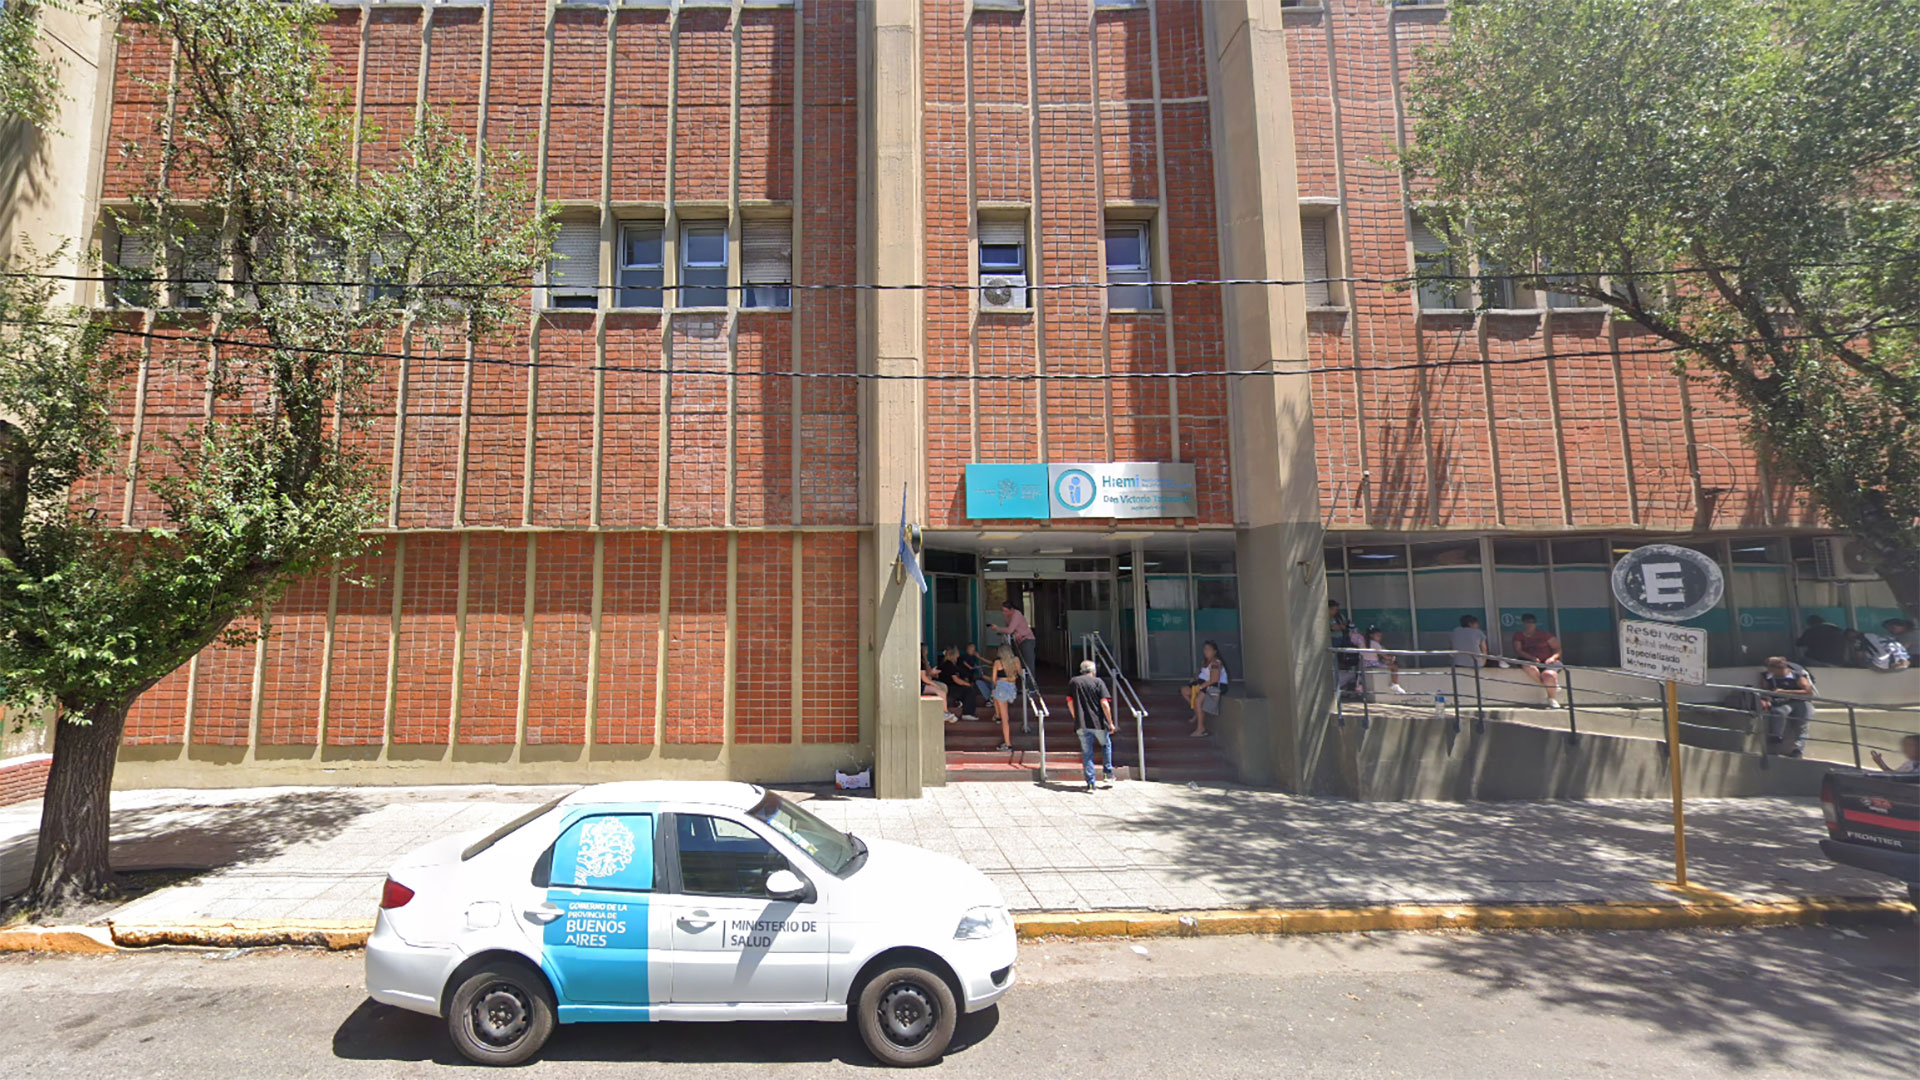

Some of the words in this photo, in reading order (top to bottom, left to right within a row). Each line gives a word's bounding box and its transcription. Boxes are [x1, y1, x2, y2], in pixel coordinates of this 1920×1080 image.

[1641, 562, 1685, 604] E
[1626, 647, 1681, 664] Especializado
[1846, 831, 1904, 848] FRONTIER
[569, 902, 606, 910] GOBIERNO
[606, 903, 617, 911] DE
[618, 904, 628, 912] LA
[568, 911, 606, 919] PROVINCIA
[566, 919, 627, 934] BUENOS
[731, 920, 800, 933] MINISTERIO
[801, 921, 817, 933] DE
[564, 933, 608, 947] AIRES
[730, 934, 772, 948] SALUD
